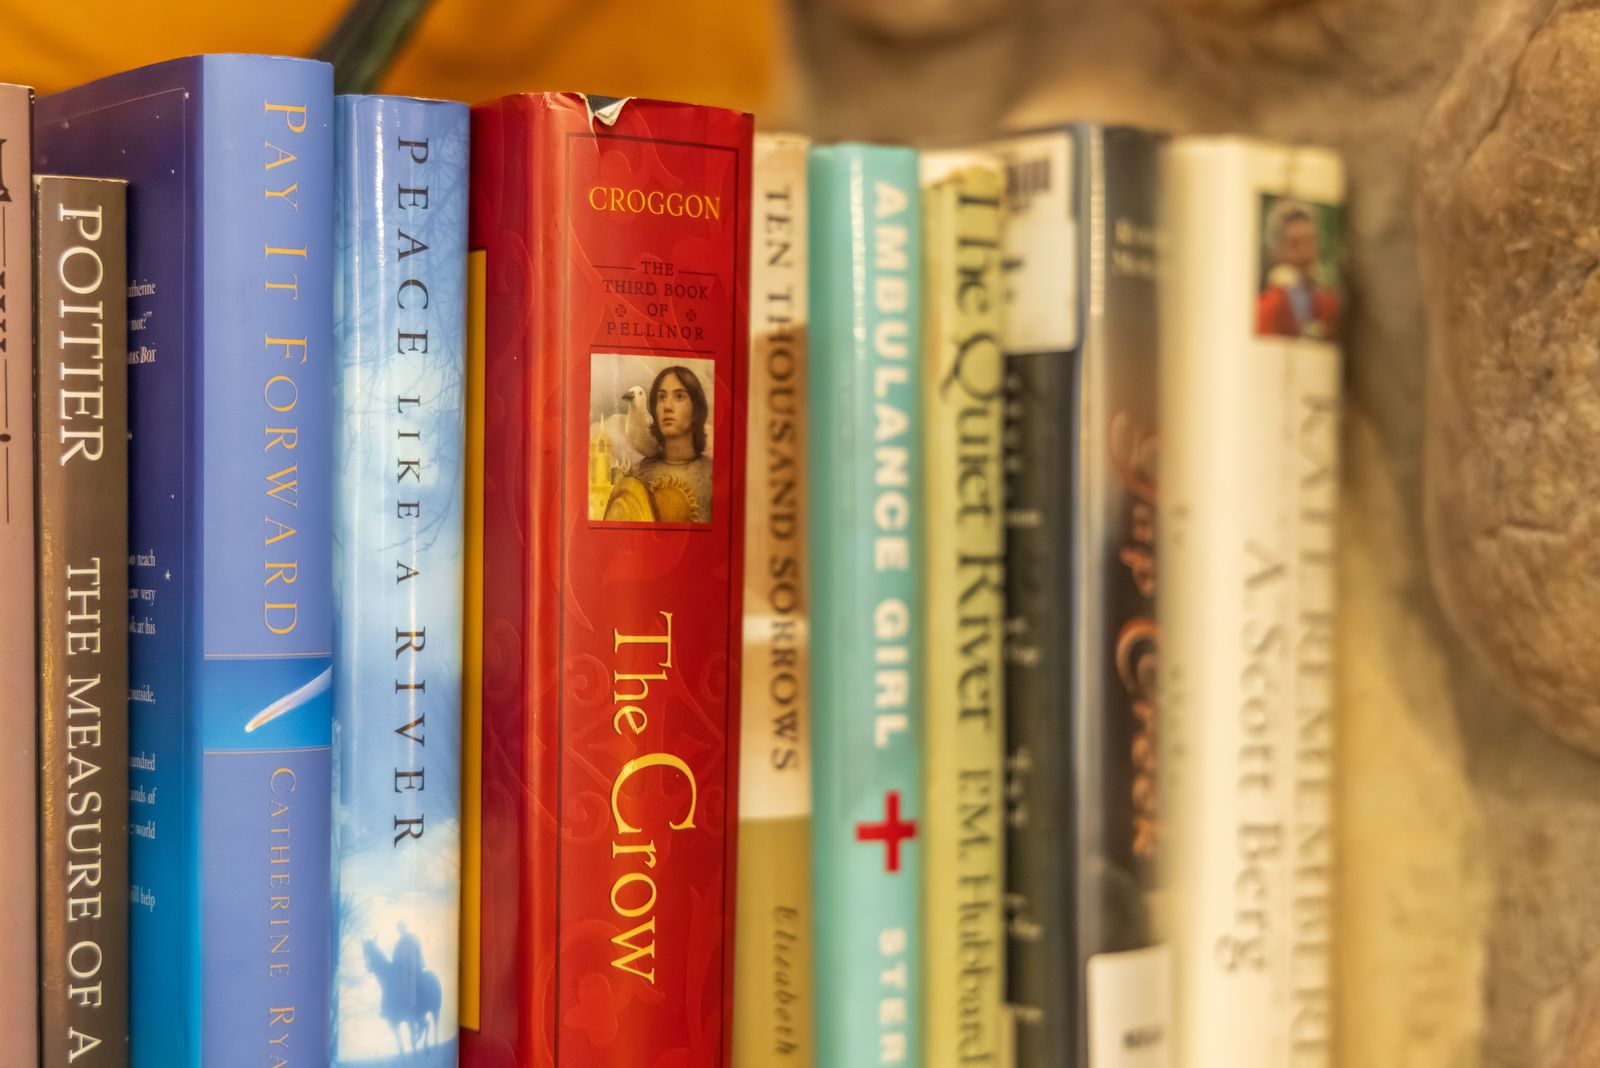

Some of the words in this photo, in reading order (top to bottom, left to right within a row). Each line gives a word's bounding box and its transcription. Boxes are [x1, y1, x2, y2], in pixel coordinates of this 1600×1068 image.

[264, 100, 308, 210] PAY
[588, 186, 721, 221] CROGGON
[264, 243, 308, 300] IT
[397, 136, 430, 355] PEACE
[641, 261, 674, 277] THE
[764, 185, 793, 268] TEN
[58, 203, 104, 466] POITIER
[603, 279, 658, 297] THIRD
[664, 281, 709, 300] BOOK
[606, 321, 705, 341] PELLINOR
[647, 303, 669, 318] OF
[767, 287, 797, 541] THOUSAND
[872, 180, 910, 572] AMBULANCE
[264, 333, 308, 635] FORWARD
[397, 394, 421, 519] LIKE
[66, 558, 102, 655] THE
[395, 561, 419, 584] A
[613, 611, 674, 737] The
[768, 552, 799, 772] SORROWS
[873, 598, 910, 749] GIRL
[956, 550, 1003, 729] River
[66, 674, 103, 921] MEASURE
[393, 626, 426, 847] RIVER
[268, 767, 297, 977] CATHERINE
[610, 752, 698, 985] Crow
[67, 940, 103, 1009] OF
[68, 1027, 103, 1064] A
